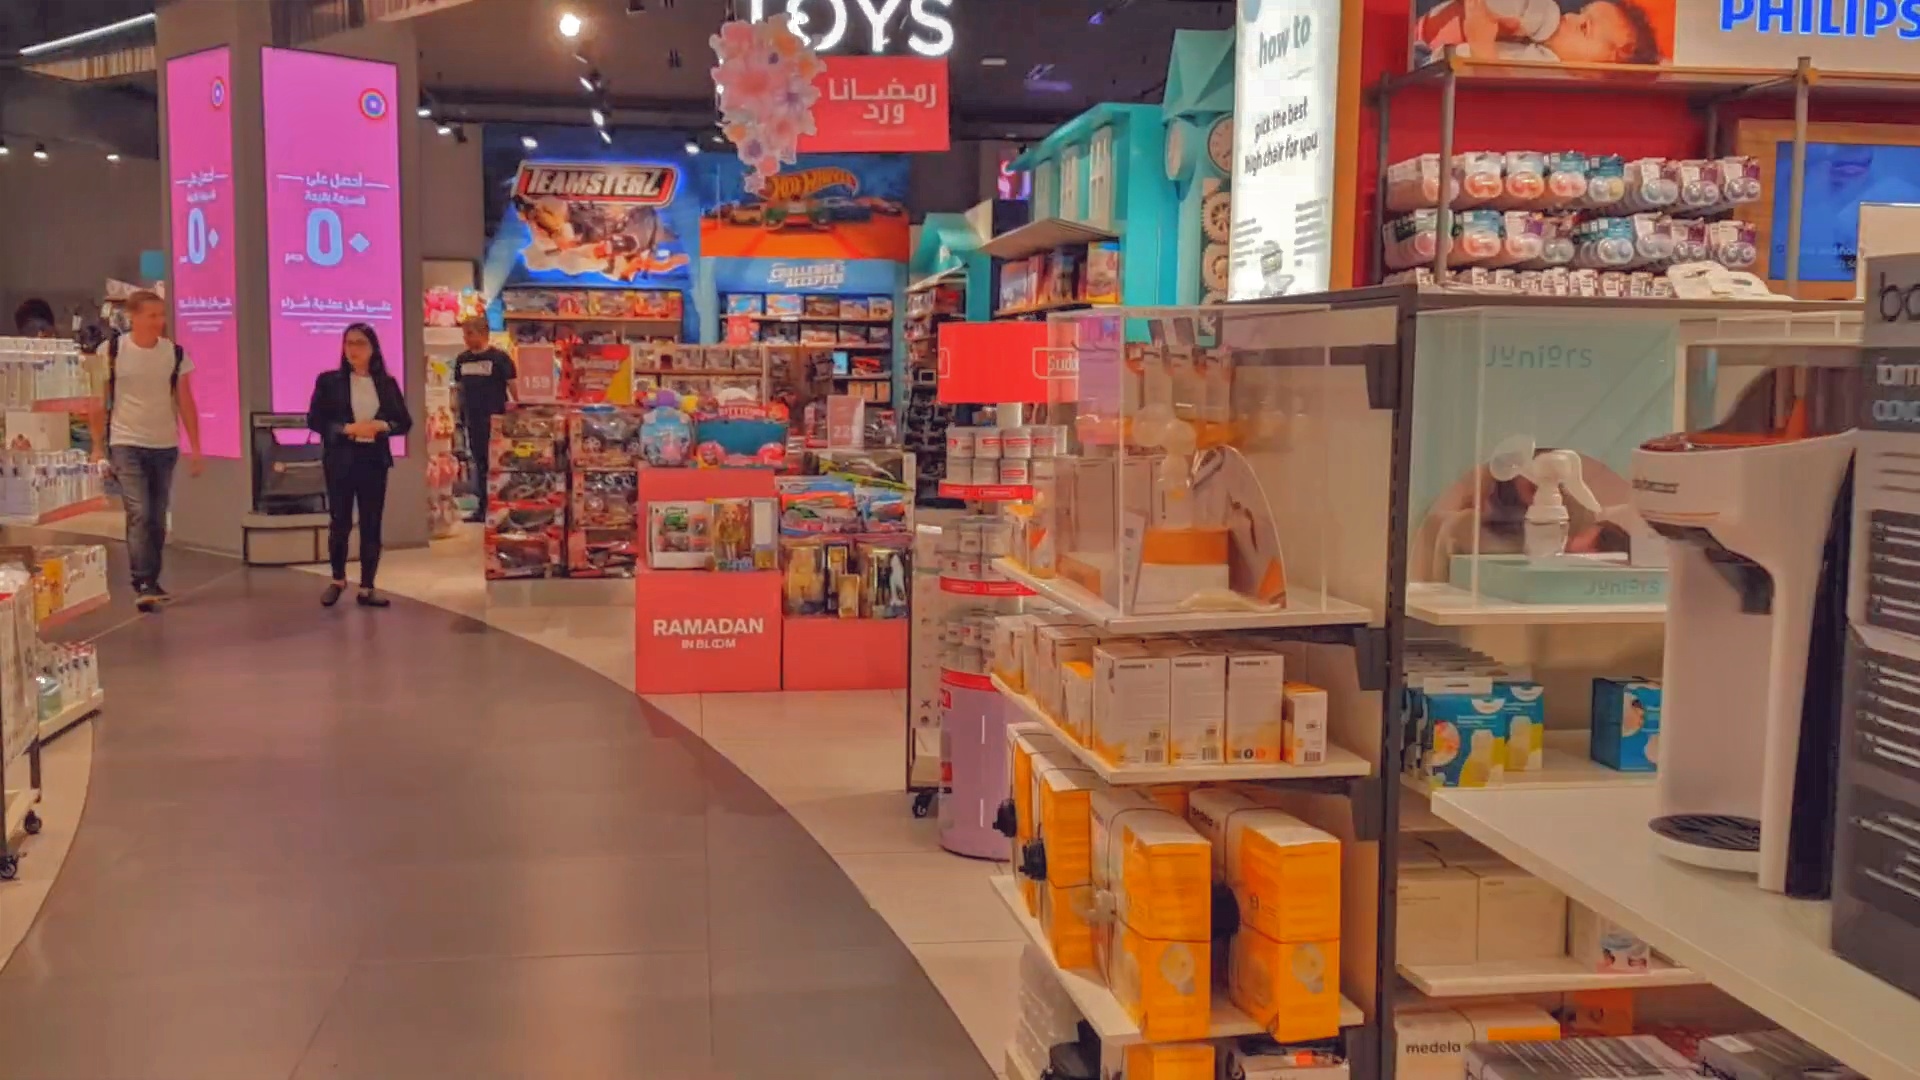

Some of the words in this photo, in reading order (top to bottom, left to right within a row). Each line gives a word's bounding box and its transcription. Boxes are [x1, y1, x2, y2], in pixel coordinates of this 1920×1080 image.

[751, 0, 954, 56] OYS
[1720, 0, 1920, 40] PHILIPS
[1259, 29, 1289, 68] how
[1293, 14, 1310, 49] to
[863, 103, 905, 125] ورد
[1254, 115, 1272, 144] pick
[1272, 108, 1288, 129] the
[1287, 95, 1308, 125] best
[1263, 142, 1284, 168] chair
[1284, 134, 1299, 160] for
[1299, 131, 1318, 161] you
[527, 166, 666, 198] TEAMSTERZ
[653, 617, 765, 637] RAMADAN
[681, 638, 695, 650] IN
[695, 637, 737, 650] BLOOM
[1405, 1041, 1462, 1055] medela
